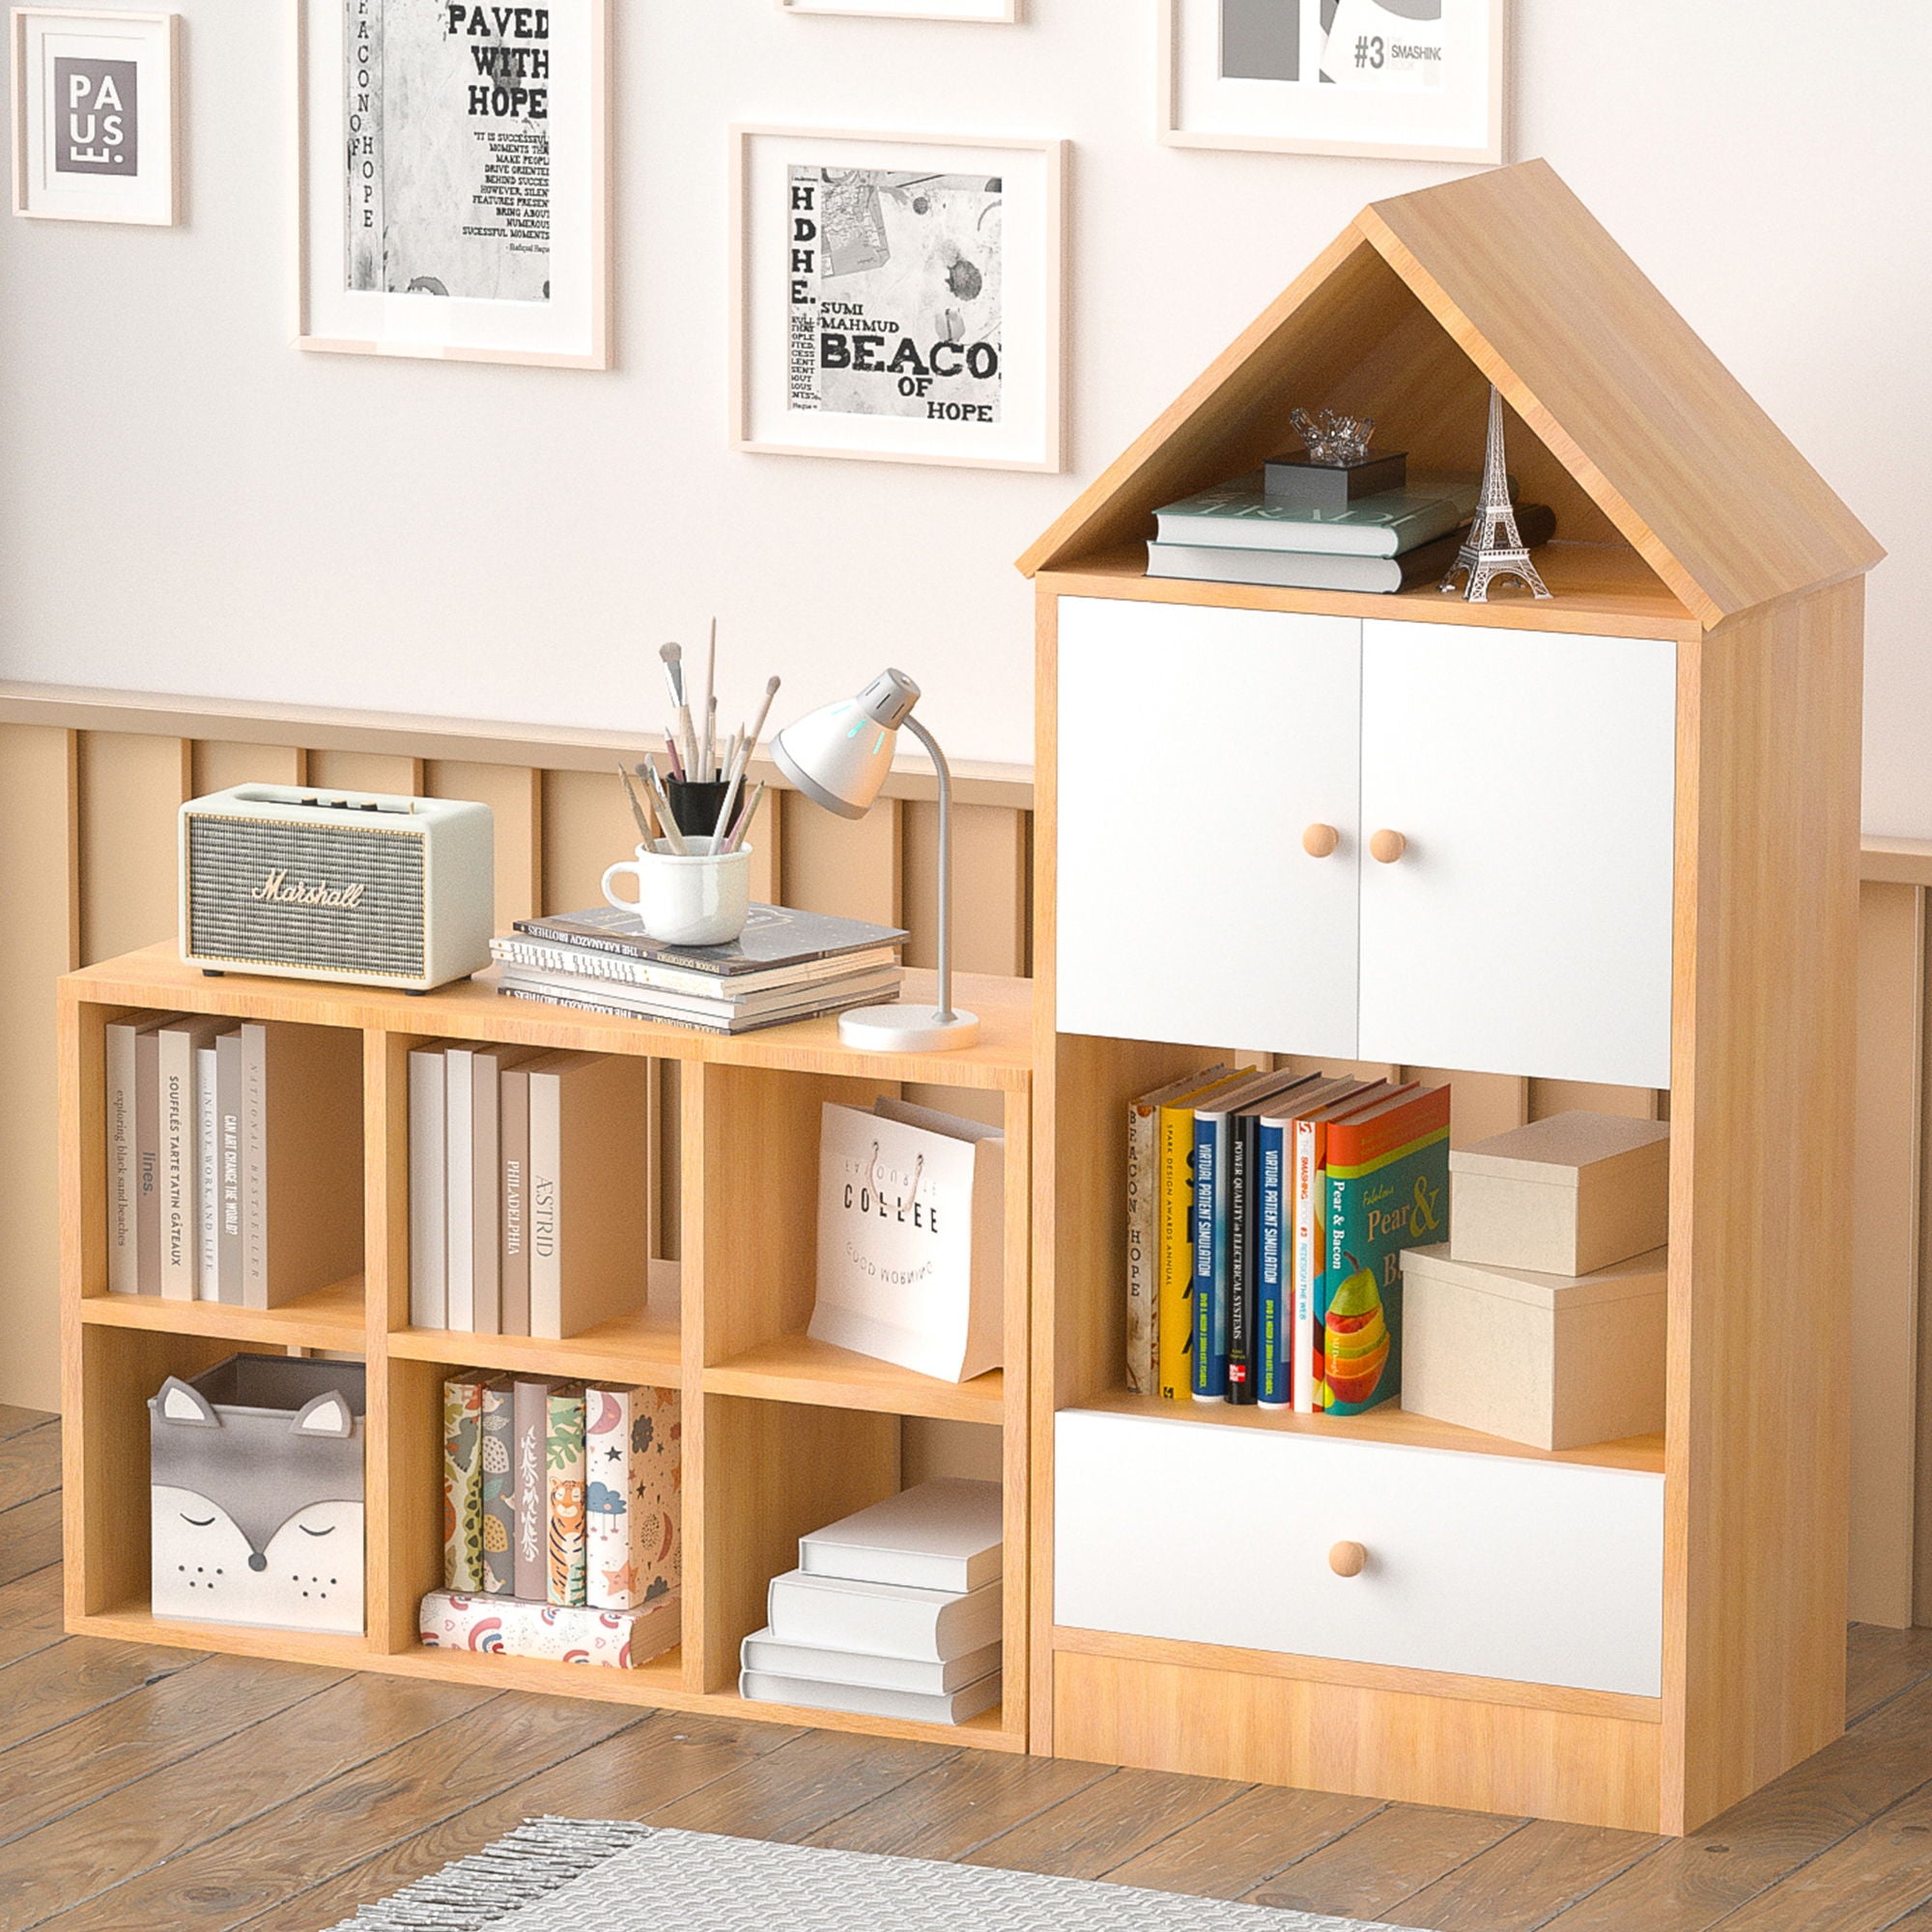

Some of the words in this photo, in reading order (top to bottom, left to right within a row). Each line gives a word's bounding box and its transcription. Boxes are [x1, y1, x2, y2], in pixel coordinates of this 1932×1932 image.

[448, 5, 549, 39] PAVED
[470, 45, 549, 79] WITH
[1354, 36, 1384, 69] #3
[468, 85, 548, 119] HOPE
[489, 143, 529, 154] MOMENTS
[496, 154, 521, 164] MAKE
[485, 164, 510, 174] DRIVE
[485, 175, 517, 185] BEHIND
[472, 195, 515, 206] FEATURES
[496, 207, 522, 216] BRING
[510, 229, 551, 240] MOMENTS
[821, 301, 864, 315] SUMI
[821, 317, 900, 333] MAHMUD
[897, 376, 933, 397] OF
[926, 401, 993, 422] HOPE
[252, 867, 366, 908] Marshall
[528, 925, 569, 944] BROTHERS
[622, 945, 639, 956] THE
[114, 1090, 127, 1142] exploring
[169, 1075, 183, 1132] SOUFFLÉS
[250, 1065, 259, 1151] NATIONAL
[224, 1114, 238, 1132] CAN
[170, 1135, 180, 1172] TARTE
[224, 1132, 238, 1151] ART
[116, 1145, 128, 1174] black
[142, 1151, 156, 1196] lines.
[224, 1150, 239, 1184] CHANGE
[1198, 1143, 1212, 1181] VIRTUAL
[1234, 1141, 1243, 1177] POWER
[1264, 1150, 1279, 1188] VIRTUAL
[117, 1176, 128, 1202] sand
[171, 1174, 181, 1208] TATIN
[224, 1184, 239, 1201] THE
[1300, 1156, 1309, 1200] SMASHING
[507, 1160, 521, 1255] PHILADELPHIA
[1198, 1182, 1212, 1220] PATIENT
[1233, 1177, 1243, 1223] QUALITY
[1264, 1189, 1278, 1228] PATIENT
[1333, 1180, 1346, 1212] Pear
[1367, 1204, 1410, 1243] Pear
[1409, 1175, 1440, 1237] &
[117, 1203, 128, 1247] beaches
[205, 1202, 213, 1231] AND
[225, 1202, 239, 1236] WORLD?
[250, 1164, 260, 1278] BESTSELLER
[1333, 1213, 1346, 1227] &
[171, 1212, 183, 1266] GÂTEAUX
[1198, 1221, 1211, 1277] SIMULATION
[1264, 1228, 1278, 1284] SIMULATION
[1332, 1229, 1345, 1270] Bacon
[1130, 1230, 1141, 1296] HOPE
[1234, 1233, 1242, 1294] ELECTRICAL
[1299, 1241, 1308, 1283] REDESIGN
[1233, 1294, 1242, 1341] SYSTEMS
